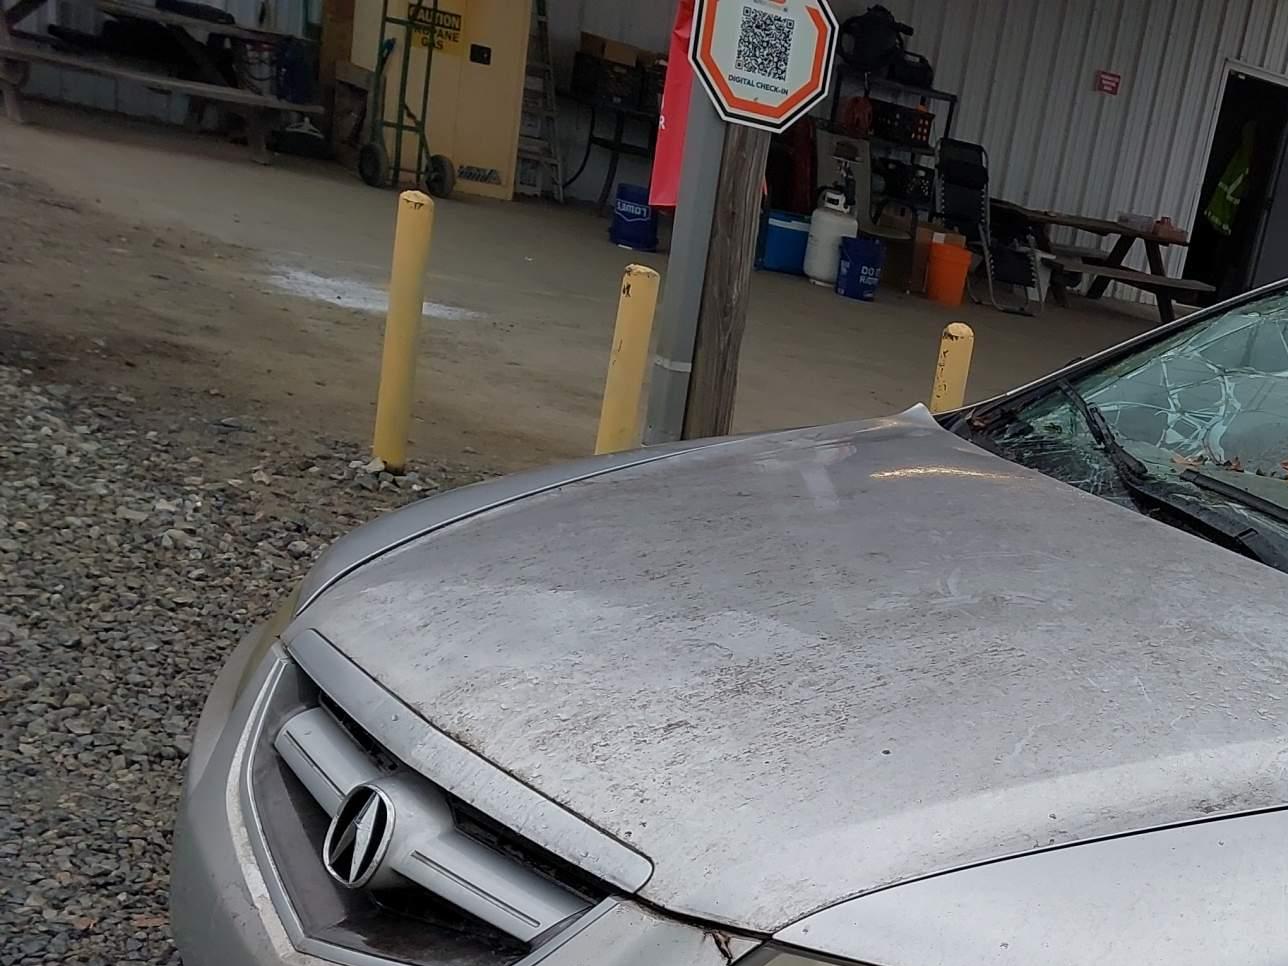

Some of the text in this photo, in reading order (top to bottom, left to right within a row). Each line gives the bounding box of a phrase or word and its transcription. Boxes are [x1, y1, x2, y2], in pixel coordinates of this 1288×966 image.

[421, 36, 444, 50] GS
[728, 74, 789, 96] DIGITAL CHECK-IN
